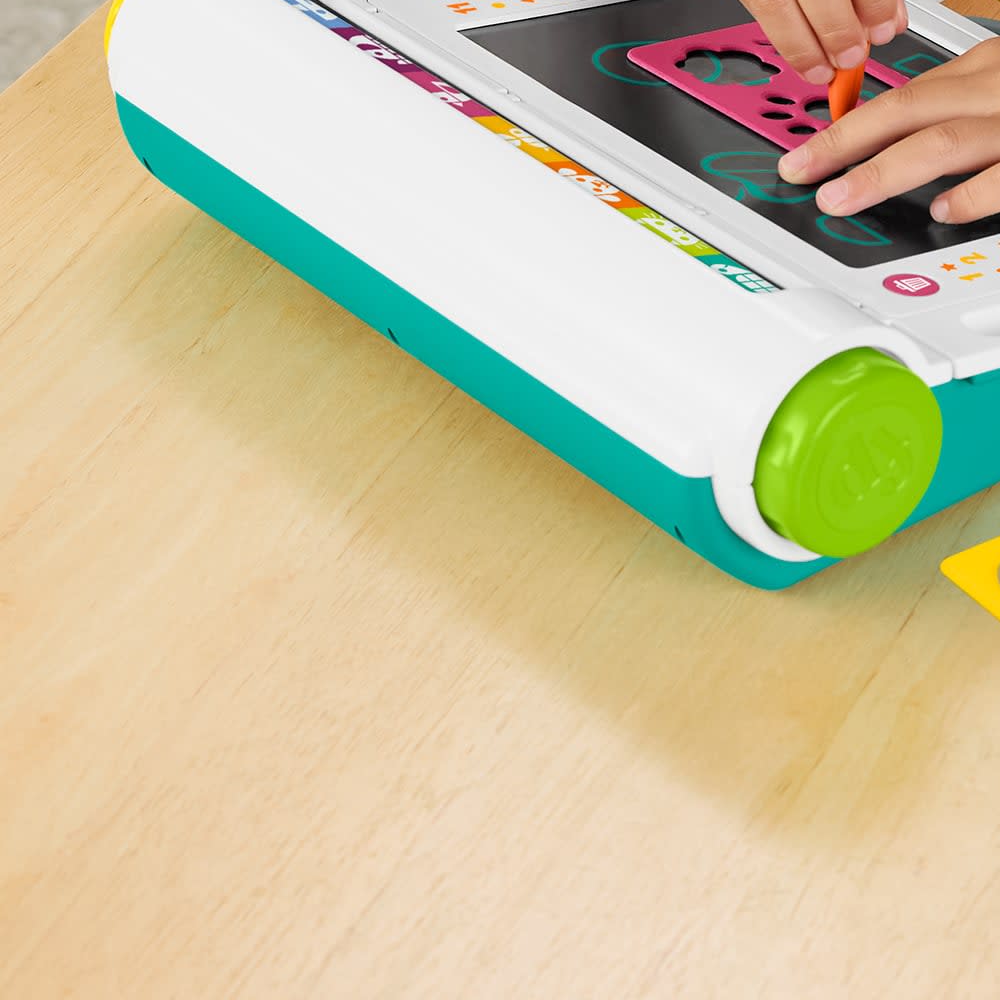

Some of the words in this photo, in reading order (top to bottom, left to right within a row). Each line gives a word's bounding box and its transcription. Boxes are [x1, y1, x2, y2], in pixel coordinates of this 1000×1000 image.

[447, 2, 477, 15] 11
[959, 252, 987, 264] 2
[958, 272, 984, 281] 1
